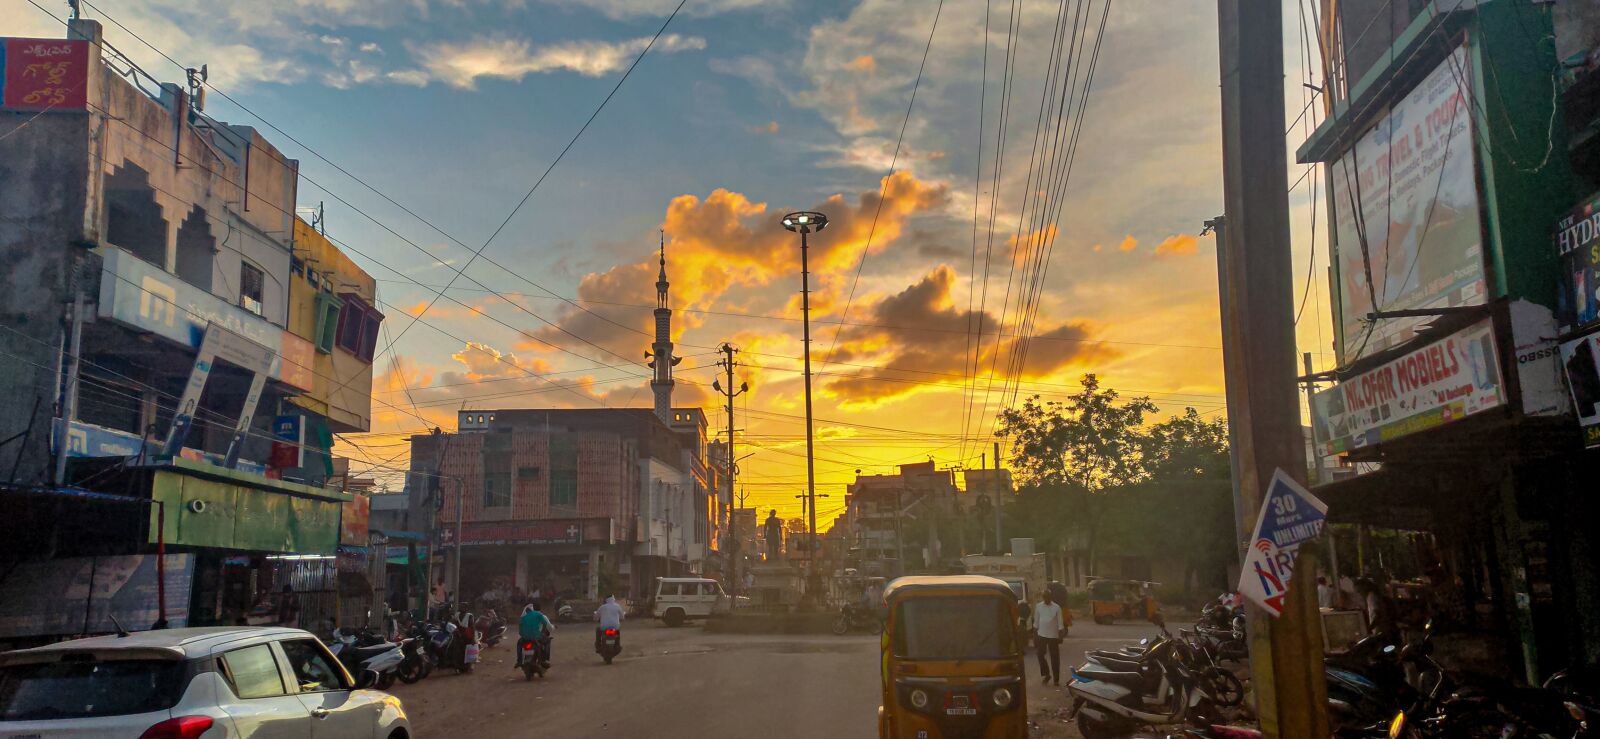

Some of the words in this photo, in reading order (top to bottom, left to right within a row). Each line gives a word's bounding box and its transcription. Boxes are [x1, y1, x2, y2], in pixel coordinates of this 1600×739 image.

[1344, 368, 1398, 412] NILOFAR
[1399, 338, 1460, 394] MOBIELS
[1271, 494, 1297, 516] 30
